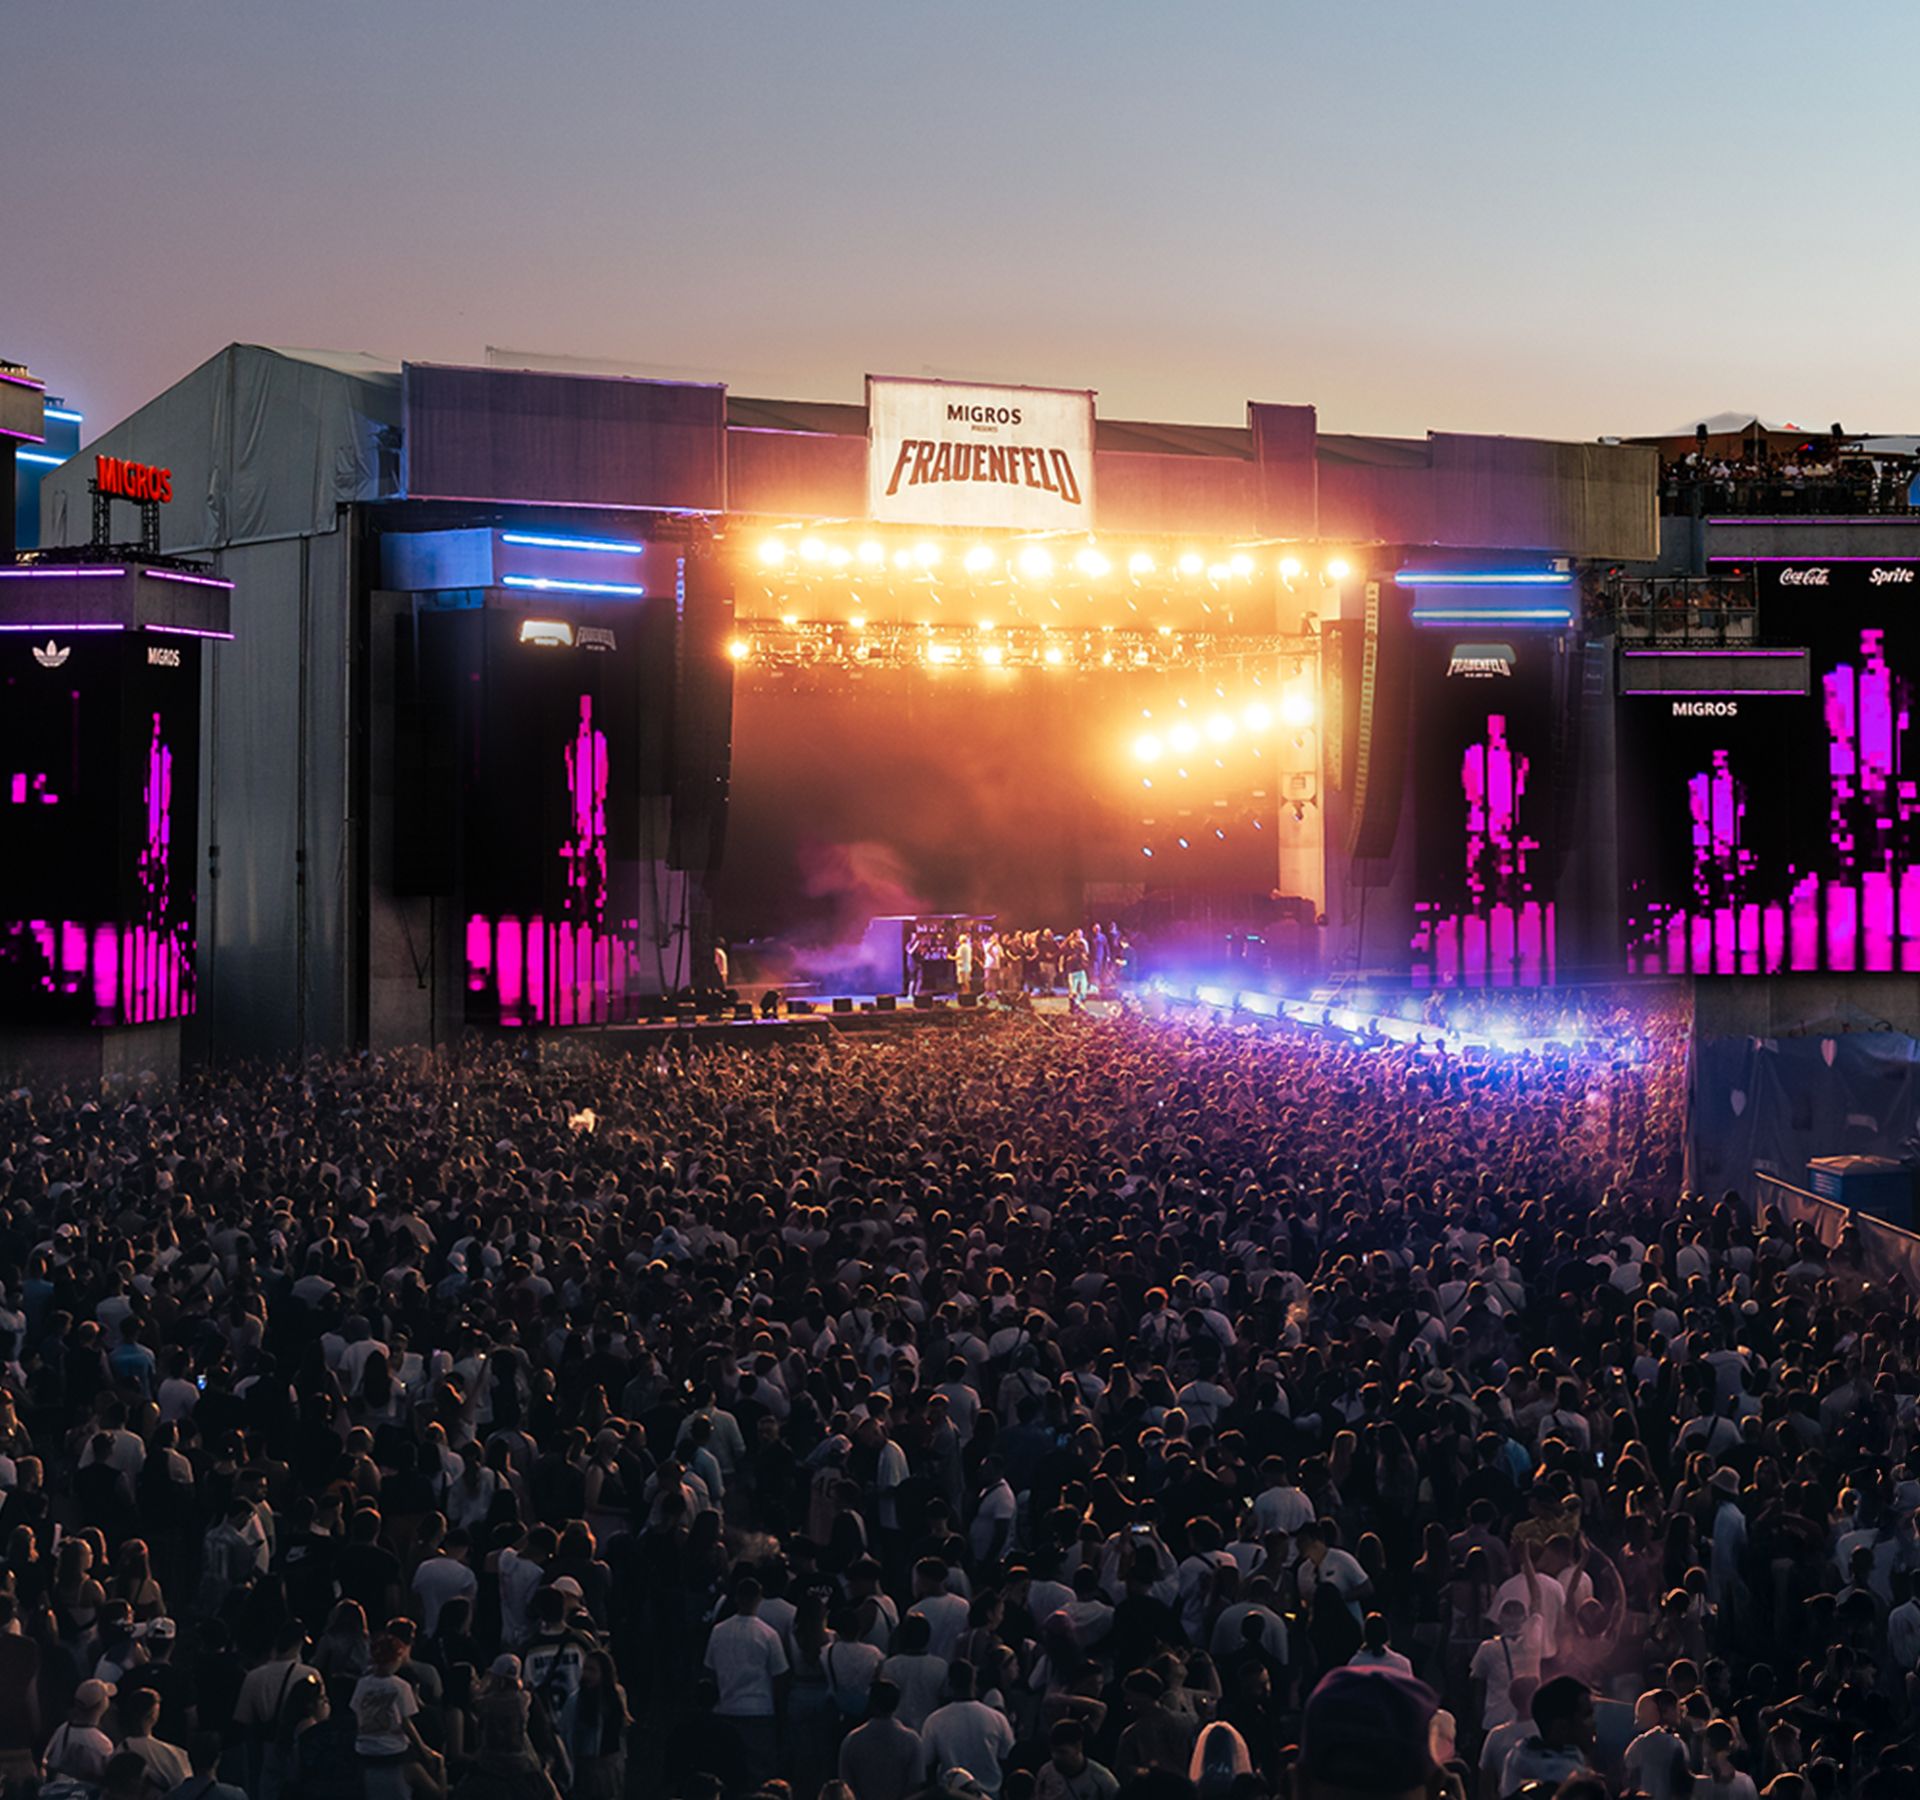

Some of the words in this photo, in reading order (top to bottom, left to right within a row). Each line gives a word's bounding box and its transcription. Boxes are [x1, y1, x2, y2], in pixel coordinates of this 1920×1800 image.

[947, 404, 1022, 425] MIGROS
[96, 454, 173, 503] MIGROS
[885, 439, 1082, 504] FRAUENFELD
[1868, 567, 1915, 586] Sprite
[147, 646, 181, 667] MIGROS
[1672, 702, 1738, 716] MIGROS
